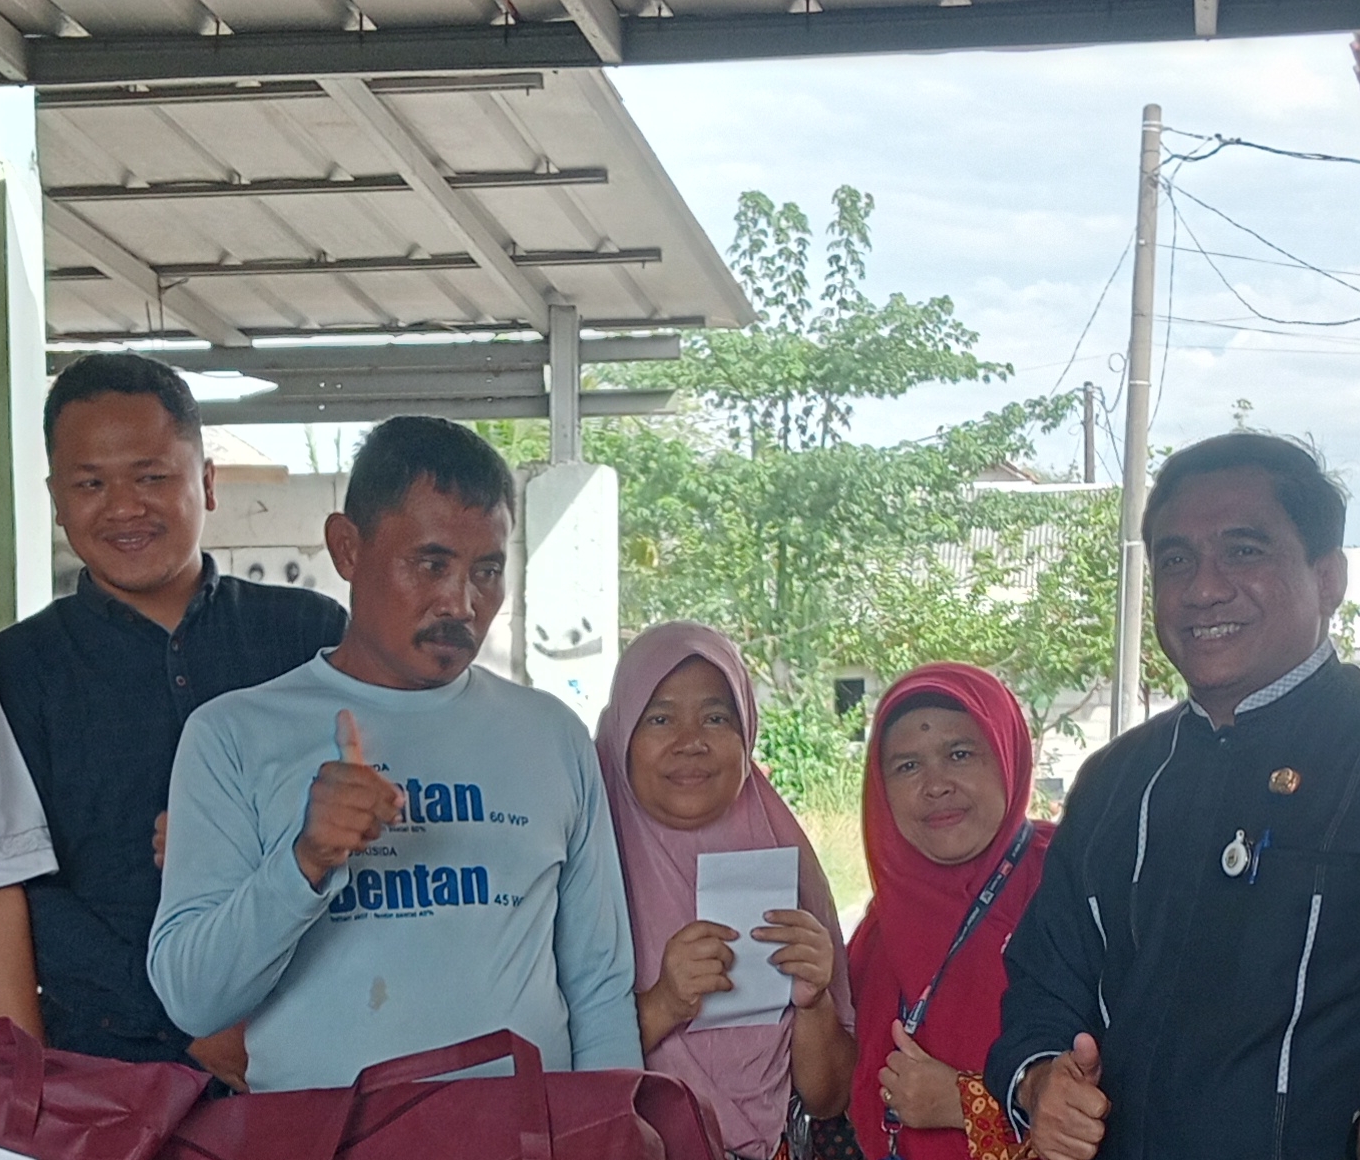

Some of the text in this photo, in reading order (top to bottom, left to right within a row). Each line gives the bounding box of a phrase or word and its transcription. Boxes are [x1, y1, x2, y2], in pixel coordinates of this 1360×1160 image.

[489, 811, 505, 824] 60
[508, 812, 530, 827] WP
[494, 893, 510, 907] 45
